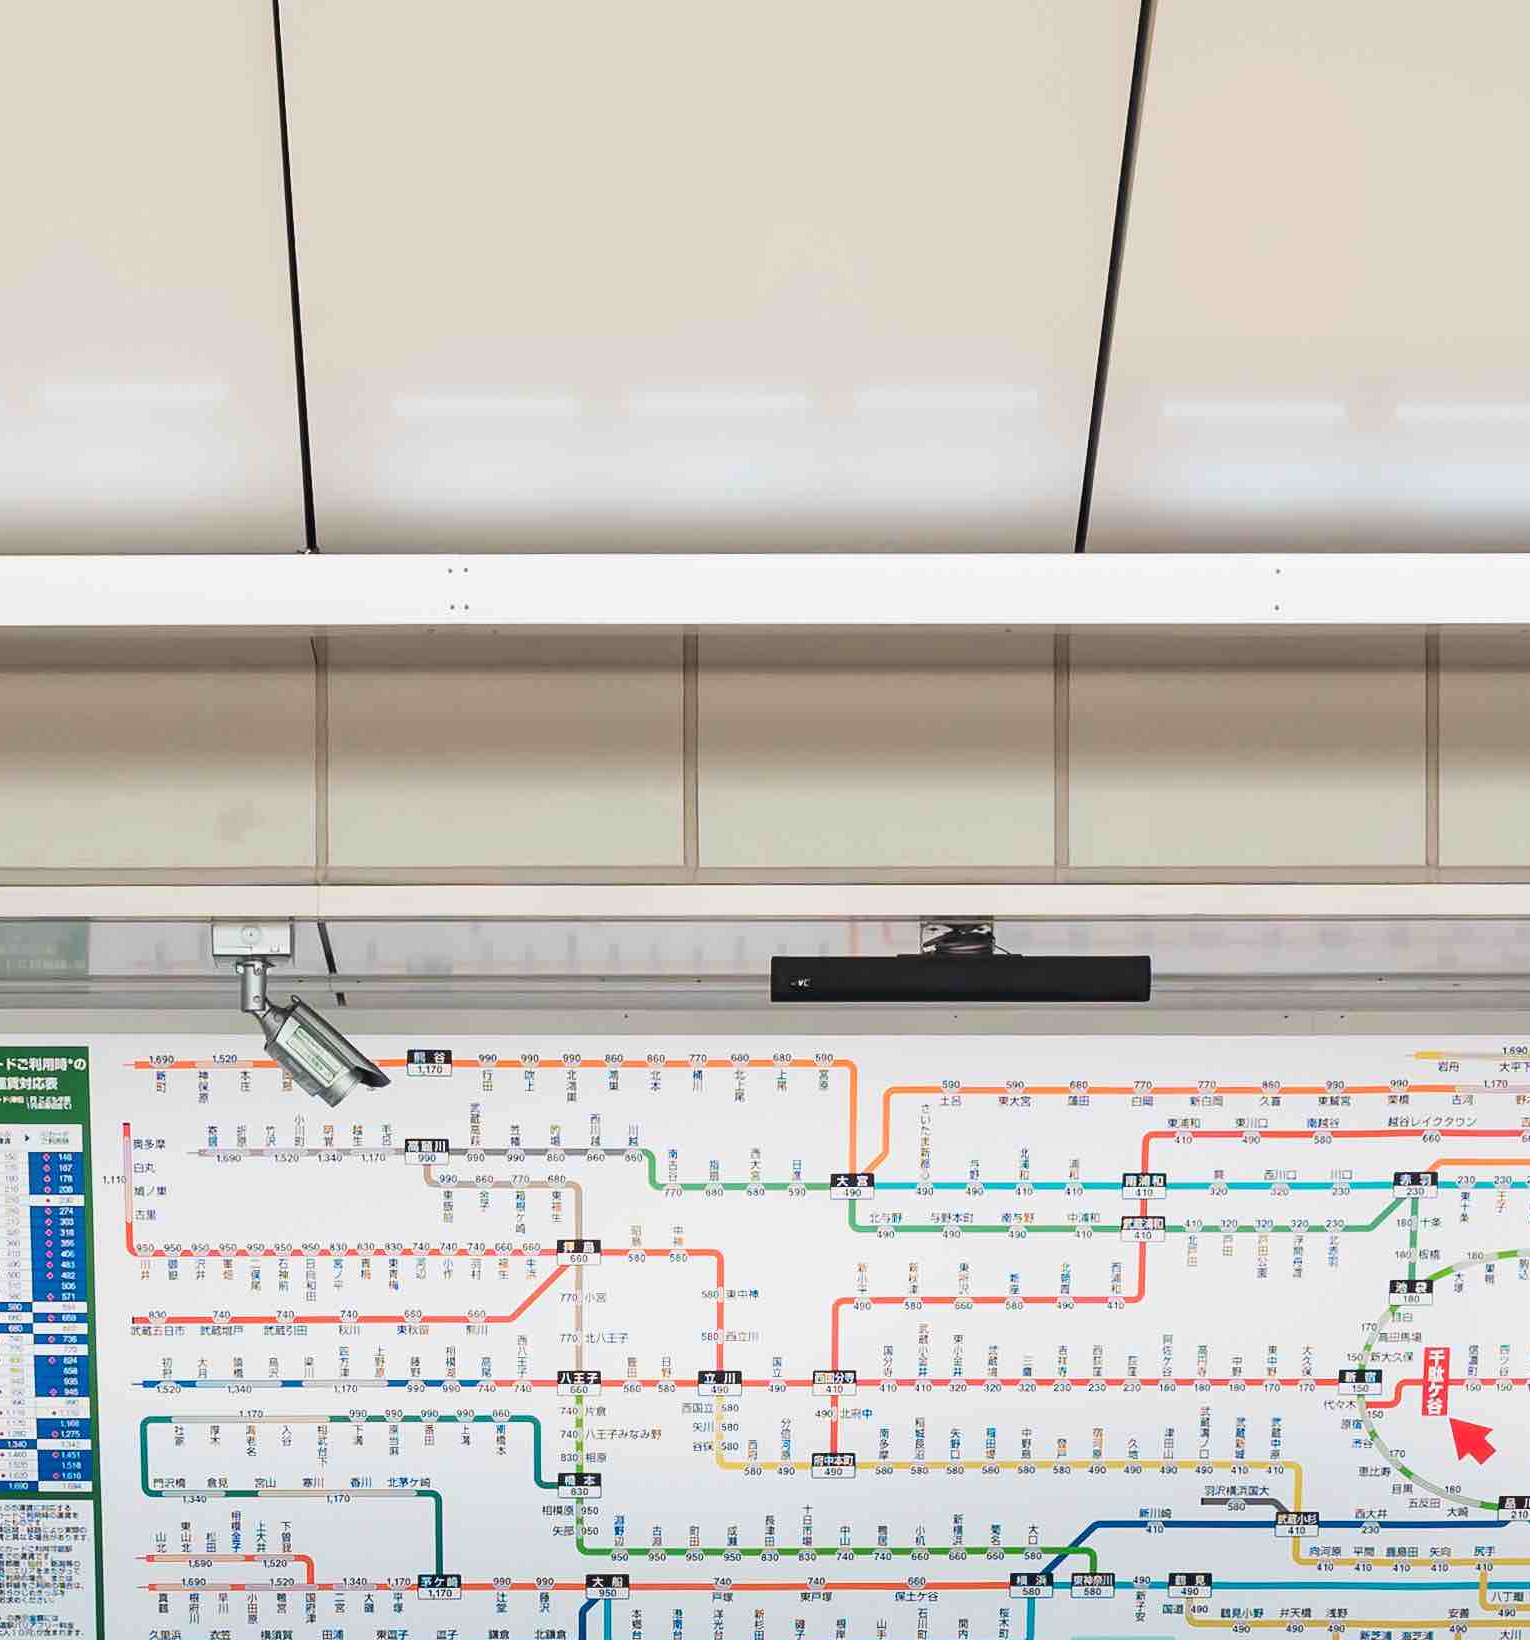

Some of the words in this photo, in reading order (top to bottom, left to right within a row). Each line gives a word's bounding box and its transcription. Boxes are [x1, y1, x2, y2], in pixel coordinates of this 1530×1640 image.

[1388, 1117, 1477, 1128] 越谷レイクタウン
[836, 1175, 868, 1187] 大宮
[711, 1385, 729, 1394] 490
[1511, 1510, 1528, 1519] 210
